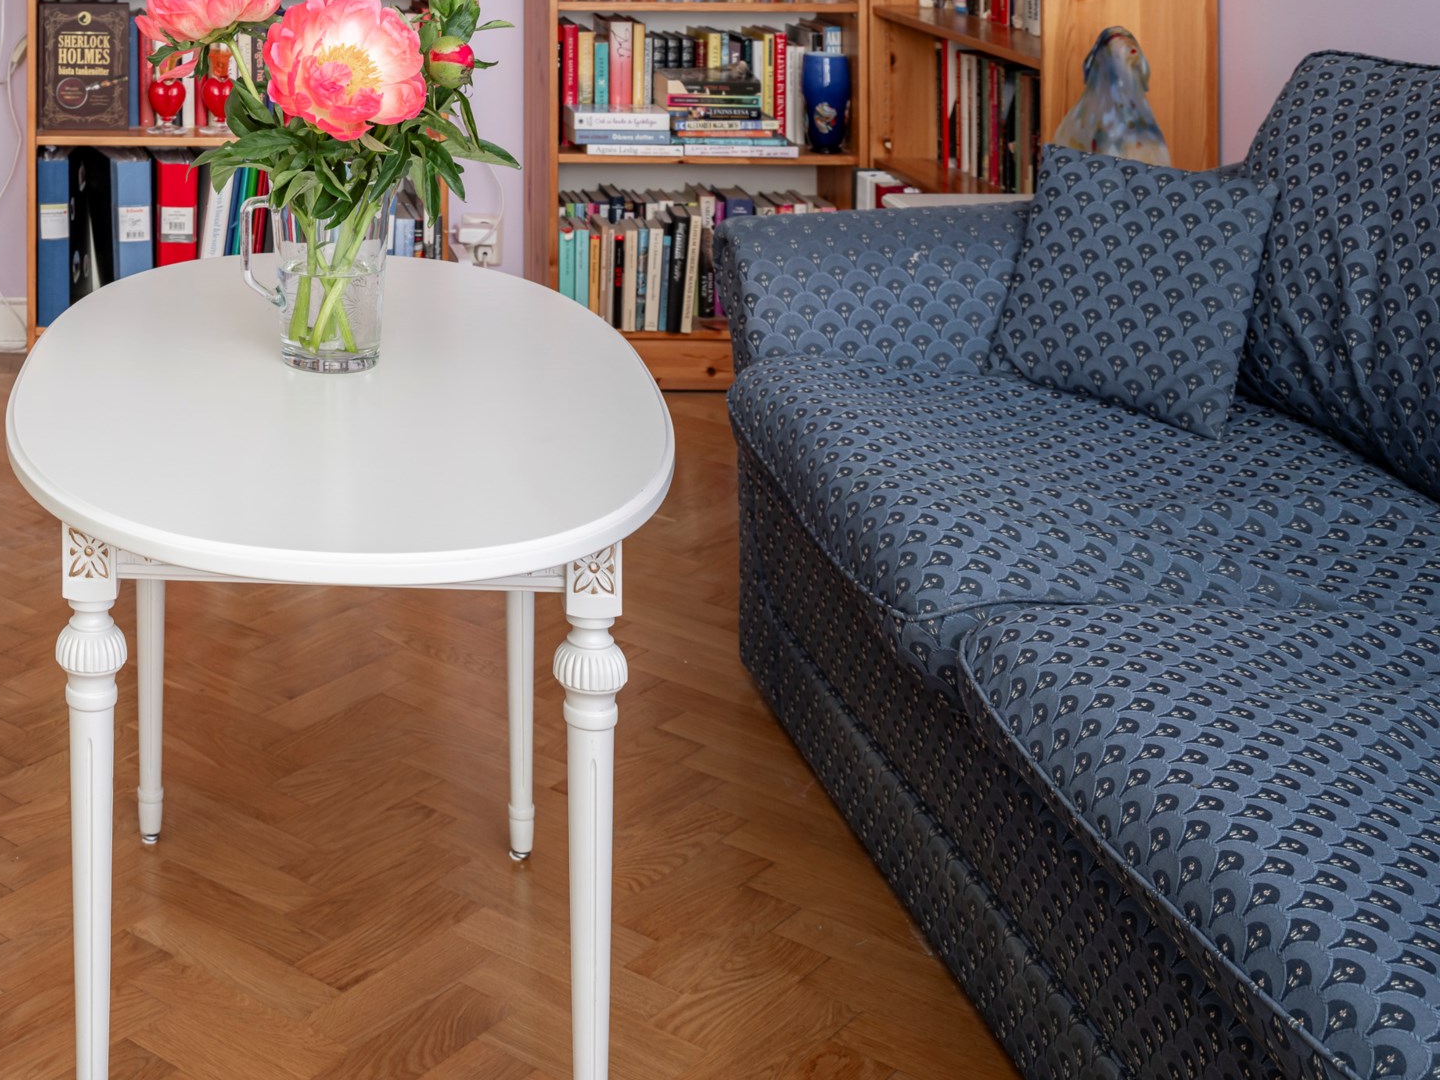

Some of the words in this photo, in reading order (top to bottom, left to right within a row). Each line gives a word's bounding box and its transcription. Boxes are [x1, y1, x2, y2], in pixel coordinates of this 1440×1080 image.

[58, 34, 110, 48] SHERLOCK
[777, 38, 785, 52] JAG
[58, 48, 110, 65] HOLMES
[58, 66, 74, 76] bästa
[777, 55, 785, 81] LEVER
[777, 84, 785, 93] PÅ
[710, 108, 733, 116] LENINS
[734, 108, 749, 116] RESA
[777, 94, 785, 116] DINA
[212, 205, 224, 228] Visual
[691, 220, 699, 248] VILHELM
